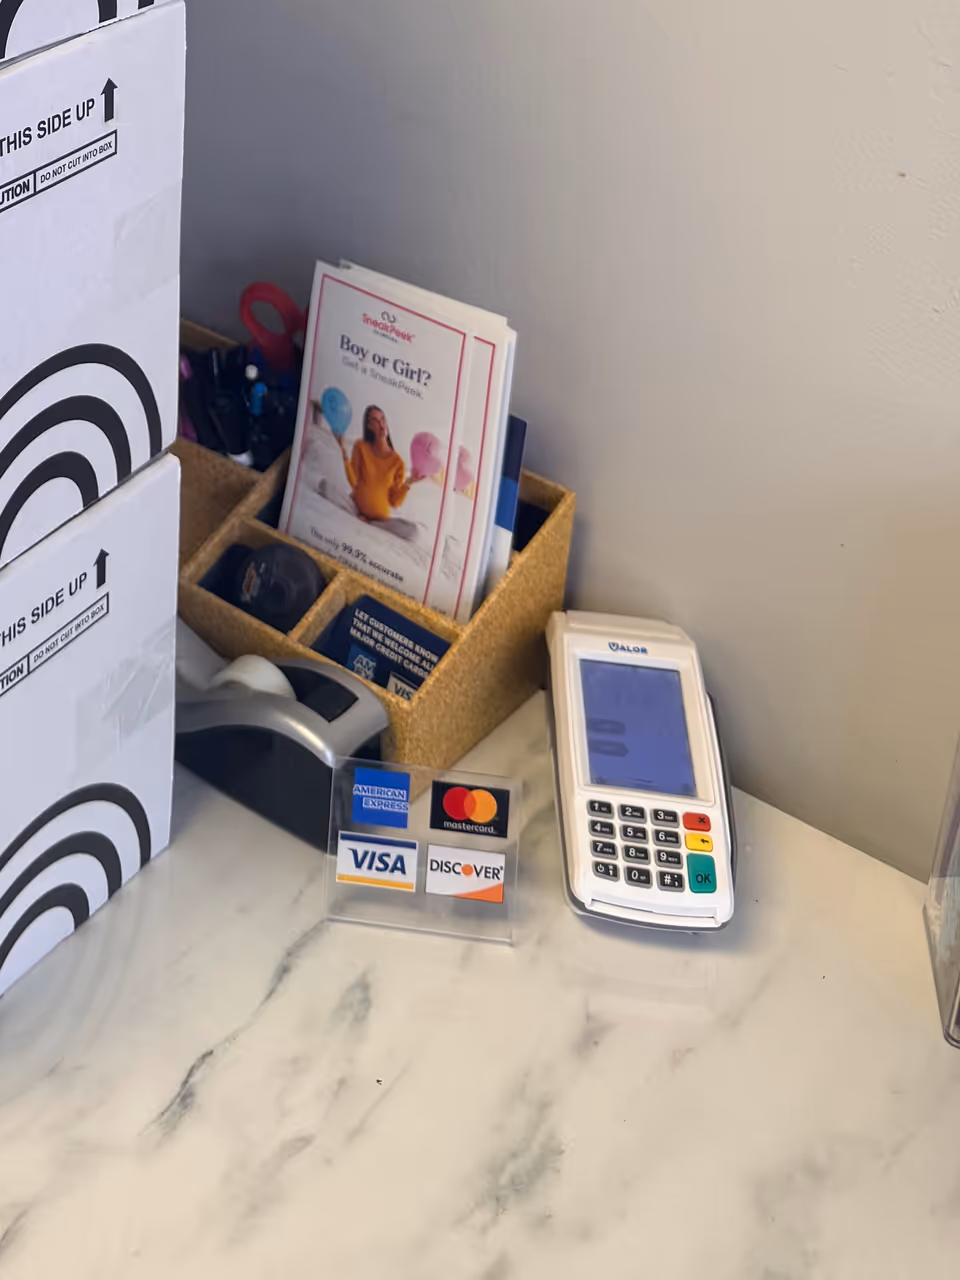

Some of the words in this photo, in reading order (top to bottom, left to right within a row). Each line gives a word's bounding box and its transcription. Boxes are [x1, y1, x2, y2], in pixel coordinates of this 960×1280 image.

[37, 108, 72, 140] SIDE
[76, 98, 95, 122] UP
[40, 171, 51, 184] DO
[52, 164, 67, 178] NOT
[68, 158, 81, 170] CUT
[82, 149, 98, 163] INTO
[99, 140, 113, 154] BOX
[339, 334, 366, 360] Boy
[372, 352, 392, 367] or
[392, 356, 432, 387] Girl?
[31, 588, 64, 625] SIDE
[69, 572, 88, 596] UP
[369, 618, 415, 647] CUSTOMERS
[415, 642, 440, 662] KNOW
[353, 784, 406, 800] AMERICAN
[363, 797, 409, 812] EXPRESS
[348, 848, 406, 875] VISA
[696, 873, 711, 884] OK
